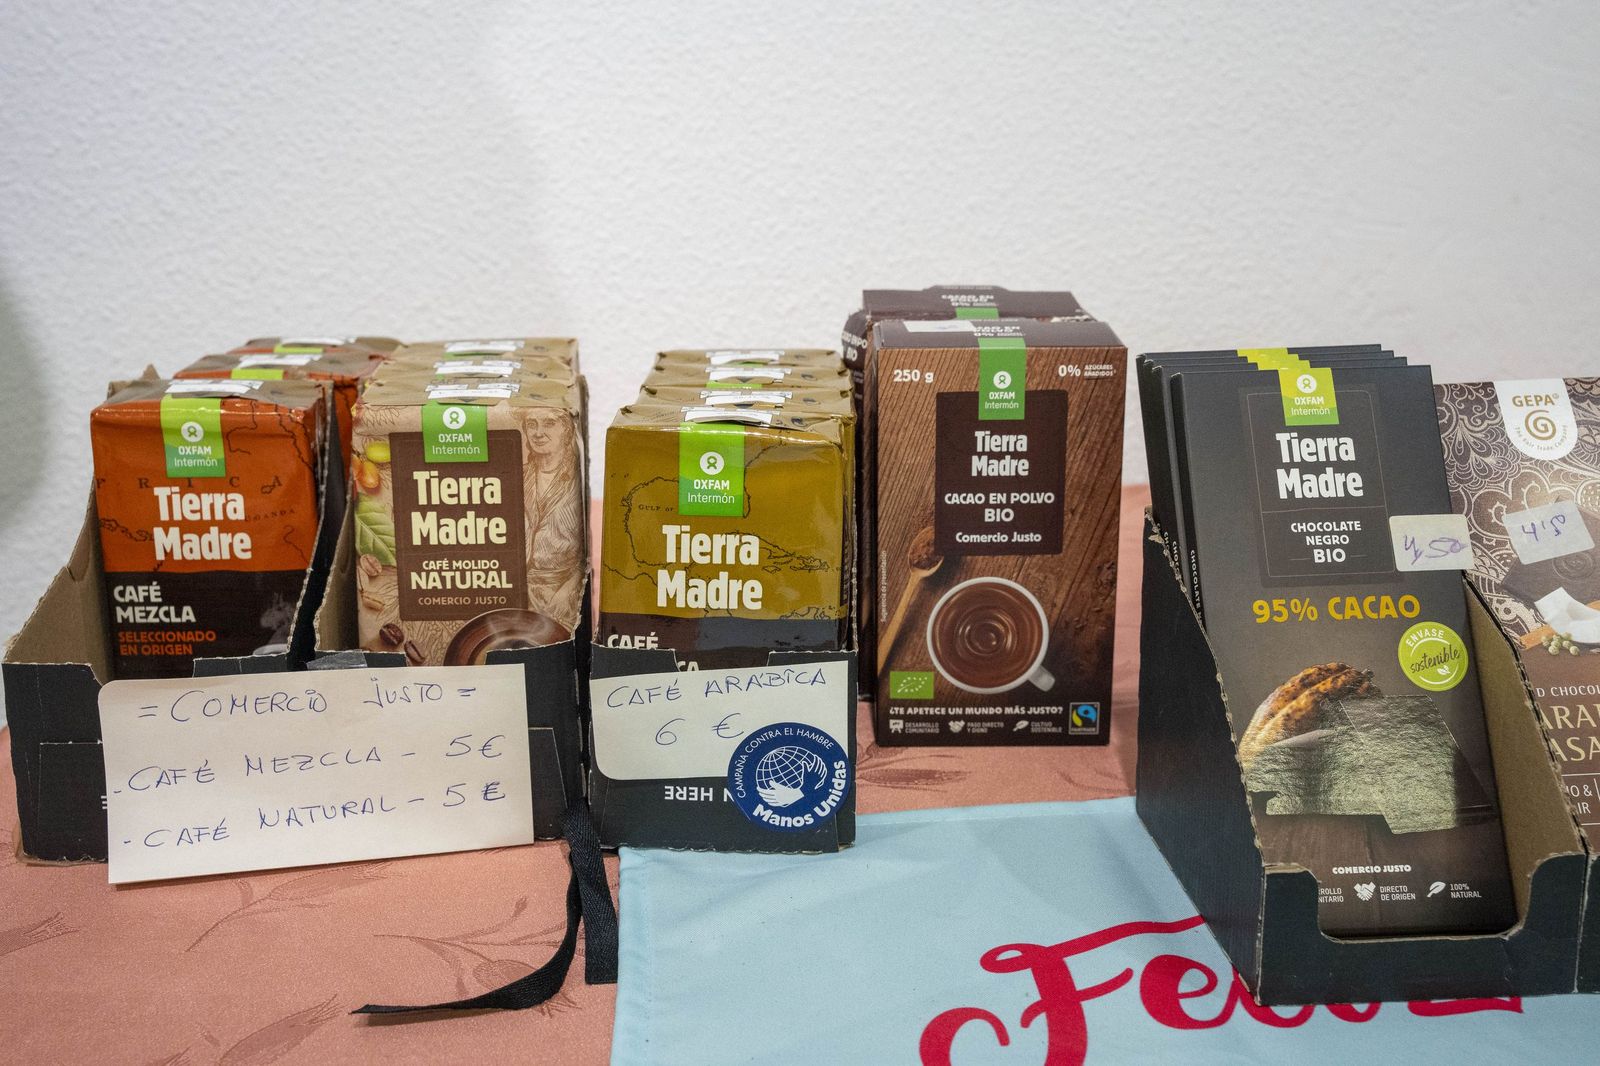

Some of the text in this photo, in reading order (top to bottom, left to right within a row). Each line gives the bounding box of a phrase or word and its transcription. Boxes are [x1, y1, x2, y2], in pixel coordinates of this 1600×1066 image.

[893, 369, 934, 383] 250 g
[1058, 364, 1081, 377] 0%
[989, 391, 1015, 400] OXFAM
[1294, 396, 1324, 405] OXFAM
[984, 401, 1019, 410] Intermón
[1291, 406, 1330, 416] Intermón
[438, 433, 473, 443] OXFAM
[975, 431, 1028, 452] Tierra
[178, 445, 212, 455] OXFAM
[432, 444, 480, 455] Intermón
[1275, 432, 1356, 463] Tierra
[174, 457, 218, 468] Intermón
[971, 455, 1029, 476] Madre
[413, 471, 501, 505] Tierra
[693, 479, 730, 490] OXFAM
[1276, 467, 1364, 499] Madre
[154, 486, 245, 521] Tierra
[688, 491, 735, 504] Intermón
[944, 492, 1055, 504] CACAO EN POLVO
[984, 508, 1014, 522] BIO
[411, 511, 507, 545] Madre
[1290, 520, 1361, 533] CHOCOLATE
[153, 526, 252, 561] Madre
[955, 532, 1042, 543] Comercio Justo
[1305, 535, 1350, 545] NEGRO
[662, 525, 760, 565] Tierra
[1313, 548, 1346, 563] BIO
[422, 558, 499, 570] CAFÉ MOLIDO
[410, 570, 513, 590] NATURAL
[113, 581, 163, 603] CAFÉ
[657, 570, 763, 610] Madre
[418, 596, 507, 606] COMERCIO JUSTO
[115, 605, 197, 623] MEZCLA
[1252, 594, 1421, 624] 95% CACAO
[118, 630, 217, 643] SELECCIONADO
[607, 632, 659, 649] CAFÉ
[1405, 628, 1445, 648] ENVASE
[120, 643, 194, 656] EN ORIGEN
[1409, 644, 1461, 674] sostenible
[607, 679, 682, 708] CAFÉ
[1551, 684, 1600, 697] CHOCOL
[889, 705, 1063, 715] ¿TE APETECE UN MUNDO MÁS JUSTO?
[128, 760, 216, 791] CAFÉ
[244, 746, 382, 777] MEZCLA
[734, 754, 749, 798] CAMPAÑA
[744, 729, 781, 754] CONTRA
[784, 727, 794, 736] EL
[796, 728, 834, 750] HAMBRE
[664, 785, 713, 801] HERE
[752, 760, 847, 828] Manos Unidas
[143, 817, 231, 848] CAFÉ
[258, 796, 397, 829] NATURAL
[1332, 864, 1412, 875] COMERCIO JUSTO
[1319, 887, 1342, 895] ROLLO
[1380, 885, 1408, 893] DIRECTO
[1450, 883, 1470, 891] 100%
[1318, 895, 1344, 903] NITARIO
[1391, 893, 1416, 901] ORIGEN
[1450, 891, 1482, 899] NATURAL
